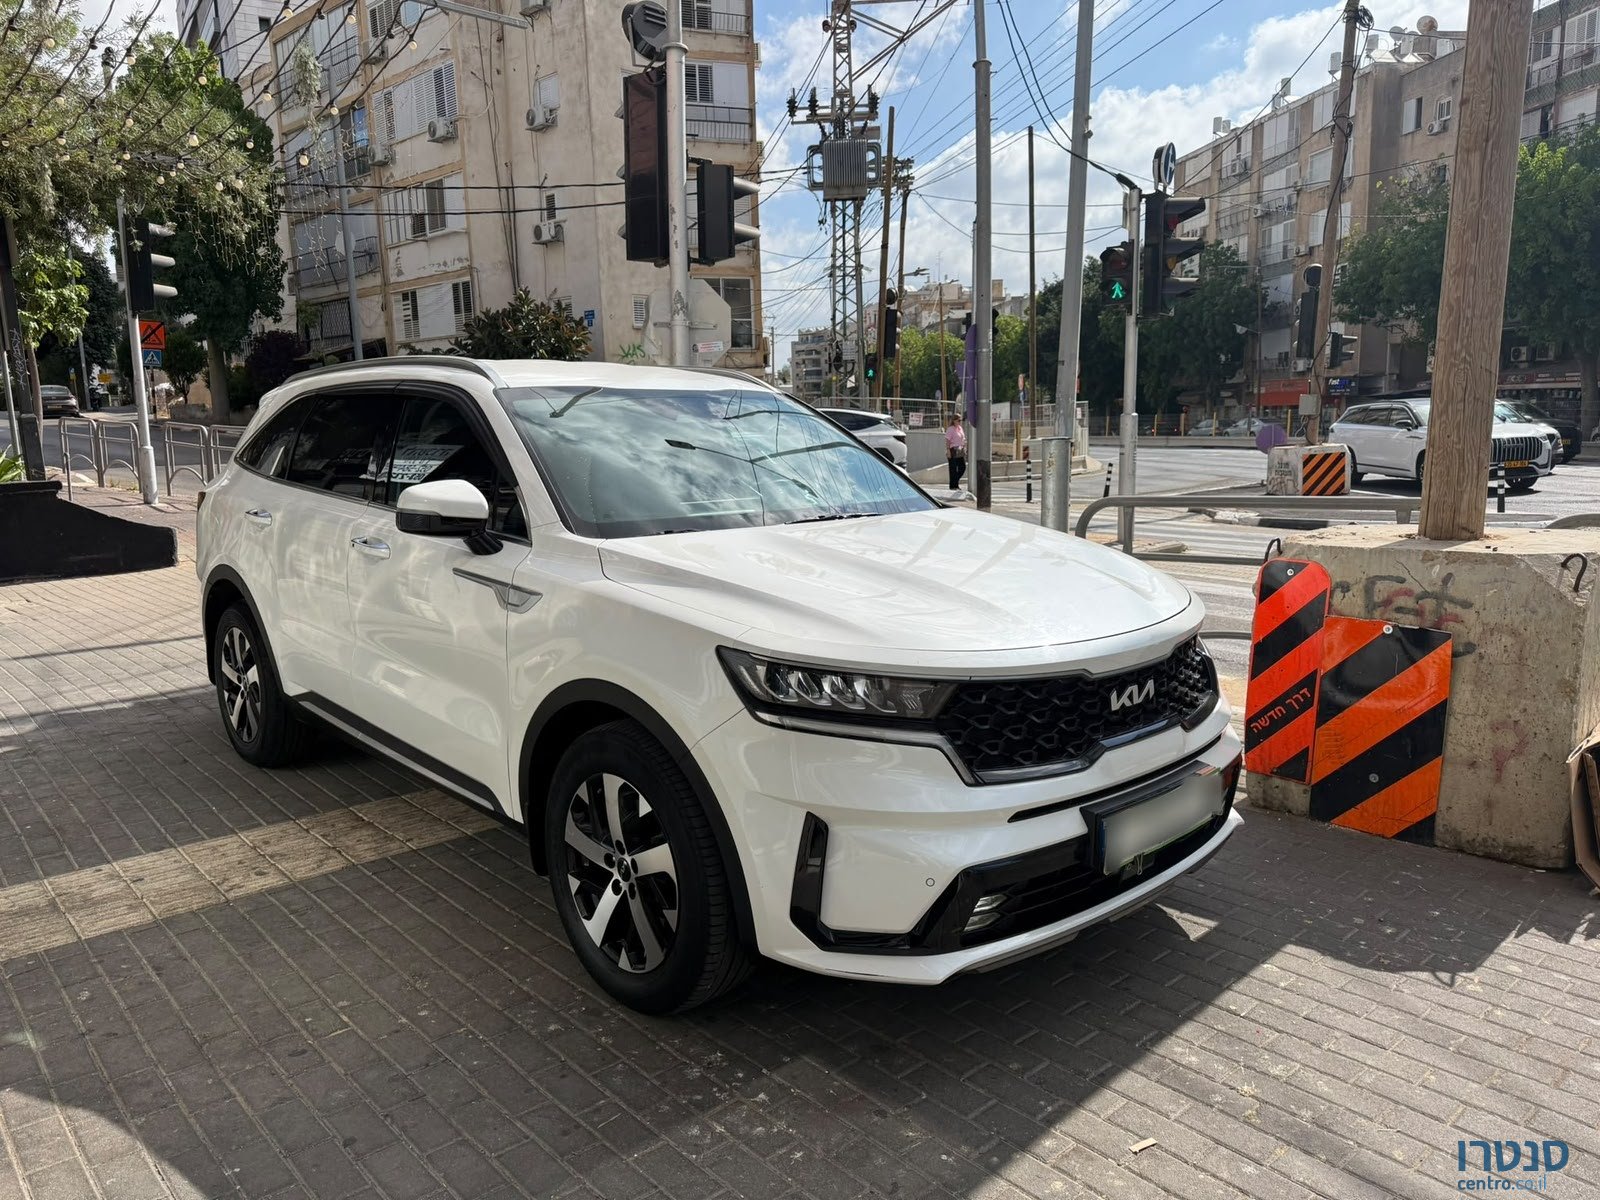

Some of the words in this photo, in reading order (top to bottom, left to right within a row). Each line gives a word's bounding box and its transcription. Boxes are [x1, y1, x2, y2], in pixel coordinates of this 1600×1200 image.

[1110, 679, 1155, 711] KIA
[1285, 687, 1311, 710] דרך
[1250, 705, 1287, 733] חדשה
